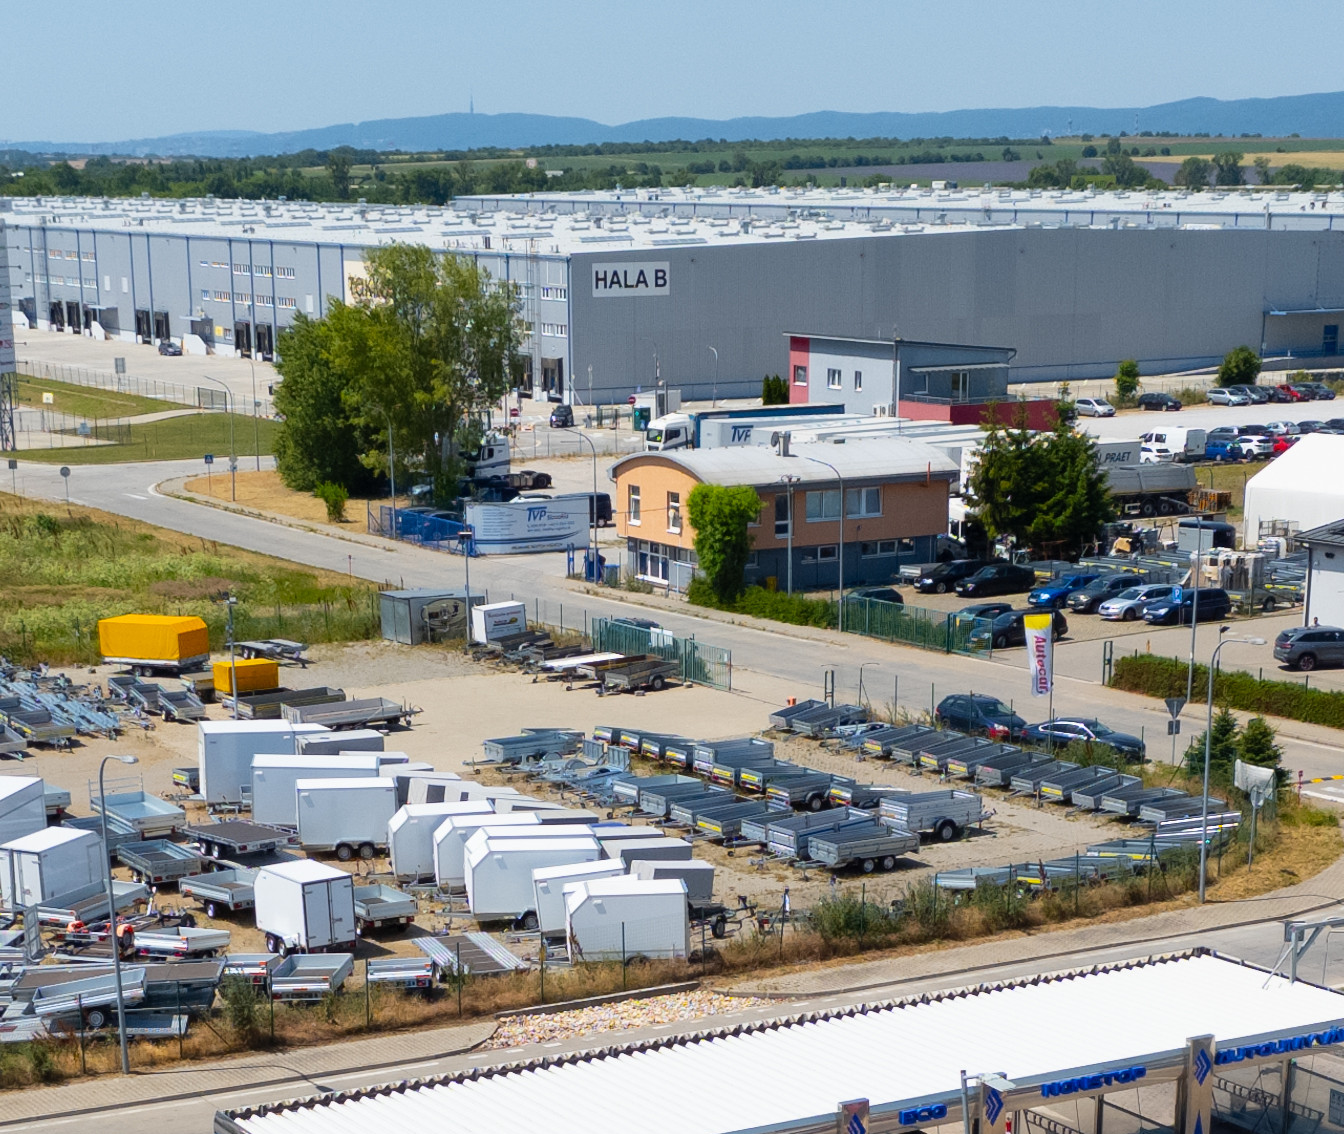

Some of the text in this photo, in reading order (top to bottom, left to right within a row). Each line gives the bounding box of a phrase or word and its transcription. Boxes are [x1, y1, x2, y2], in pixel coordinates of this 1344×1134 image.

[595, 268, 667, 289] HALA B
[731, 425, 754, 443] TVP
[526, 506, 547, 522] TVP
[1034, 635, 1049, 692] Autocar
[1040, 1065, 1147, 1098] NONSTOP
